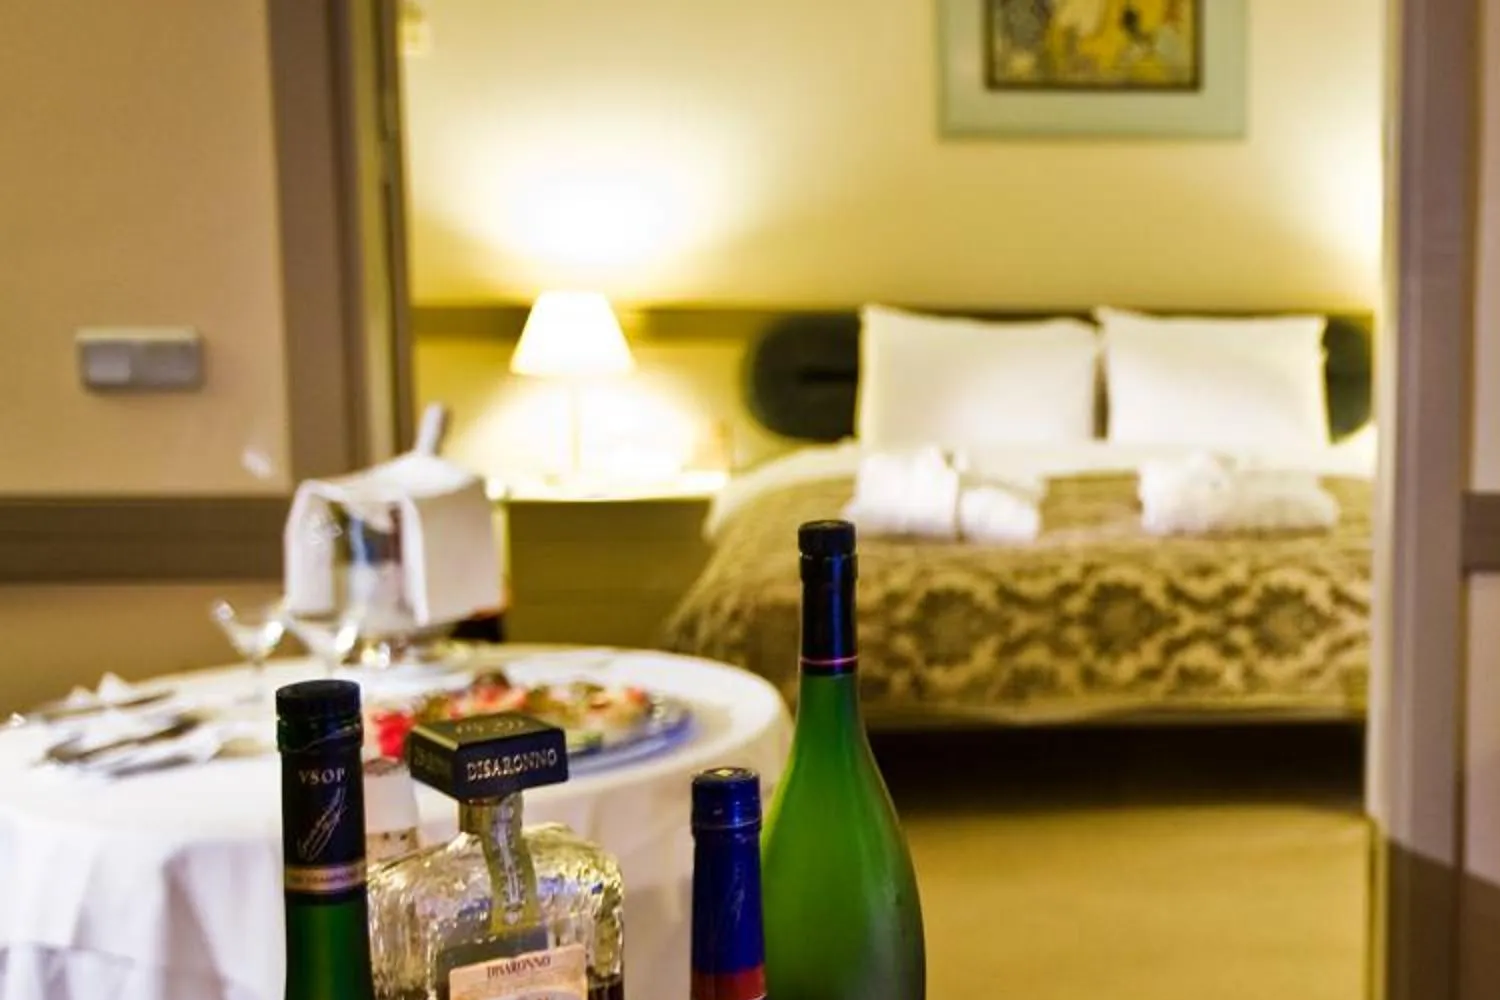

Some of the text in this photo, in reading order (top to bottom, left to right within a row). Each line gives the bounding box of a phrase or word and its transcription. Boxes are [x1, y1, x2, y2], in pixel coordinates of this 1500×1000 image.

[298, 767, 345, 785] VSOP
[465, 747, 558, 782] DISARONNO
[486, 955, 552, 979] DISARONNO
